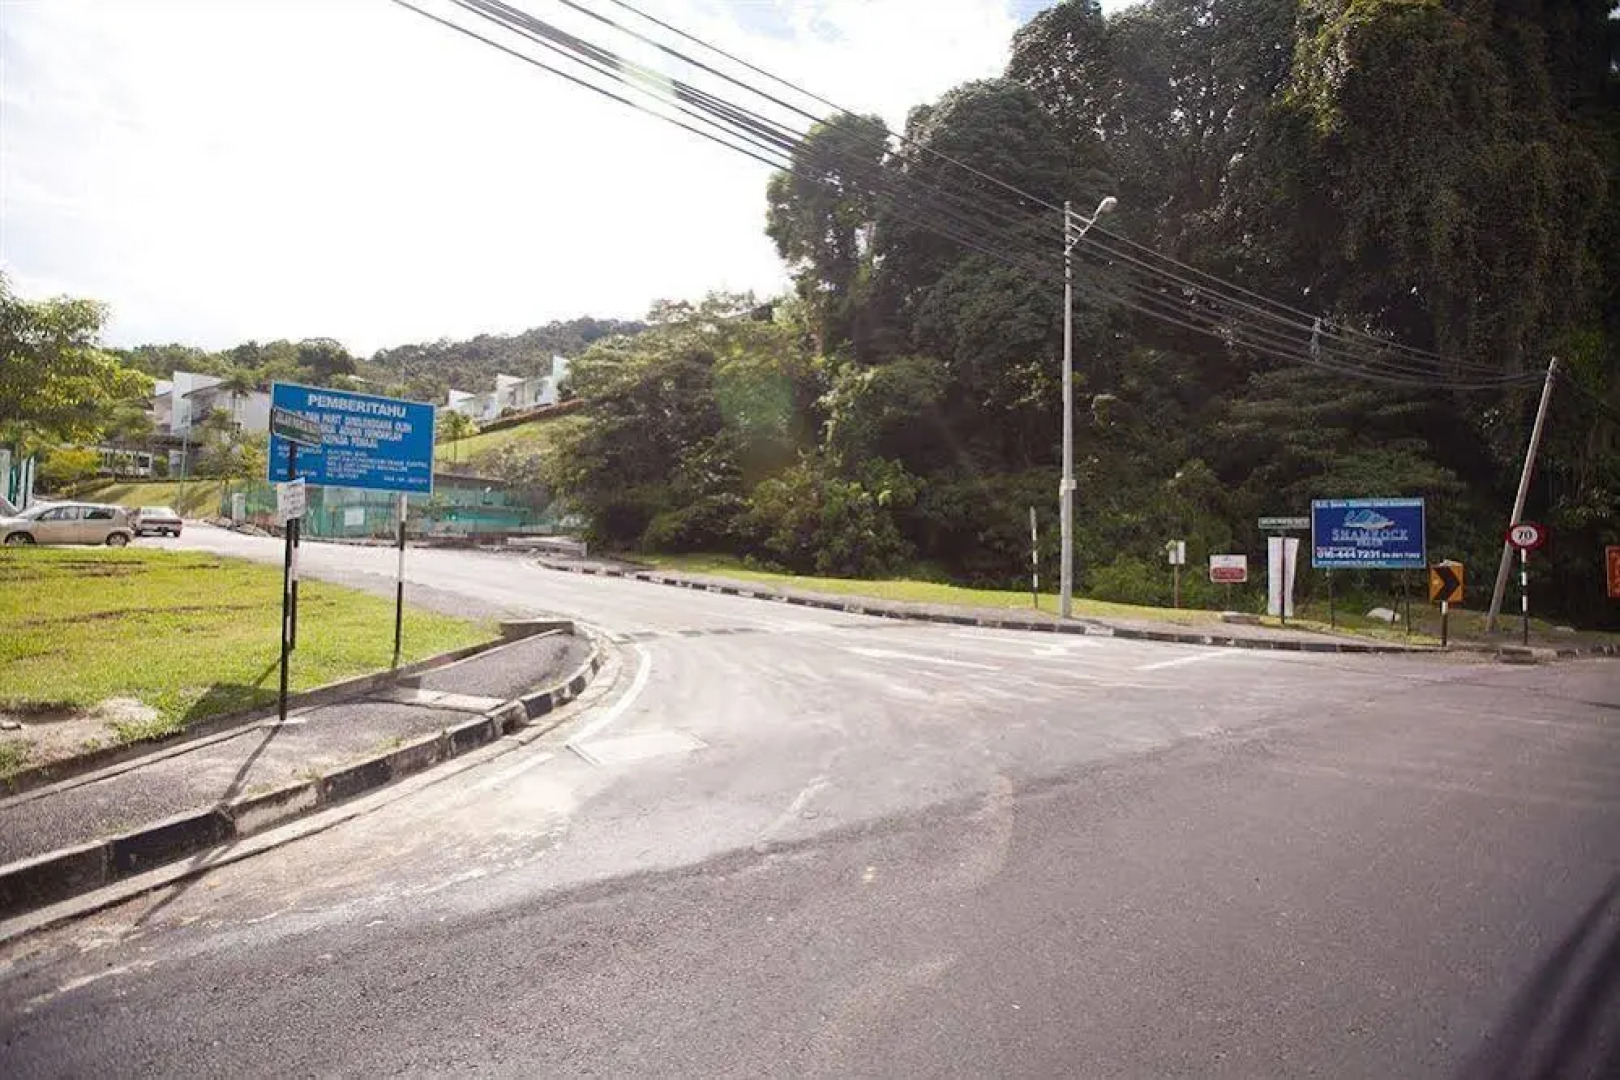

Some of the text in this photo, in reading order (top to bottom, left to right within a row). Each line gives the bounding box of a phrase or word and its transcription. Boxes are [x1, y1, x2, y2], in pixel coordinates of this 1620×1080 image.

[308, 394, 406, 417] PEMBERITAHU
[1332, 529, 1408, 541] SHAMROCK
[1517, 531, 1533, 540] 70
